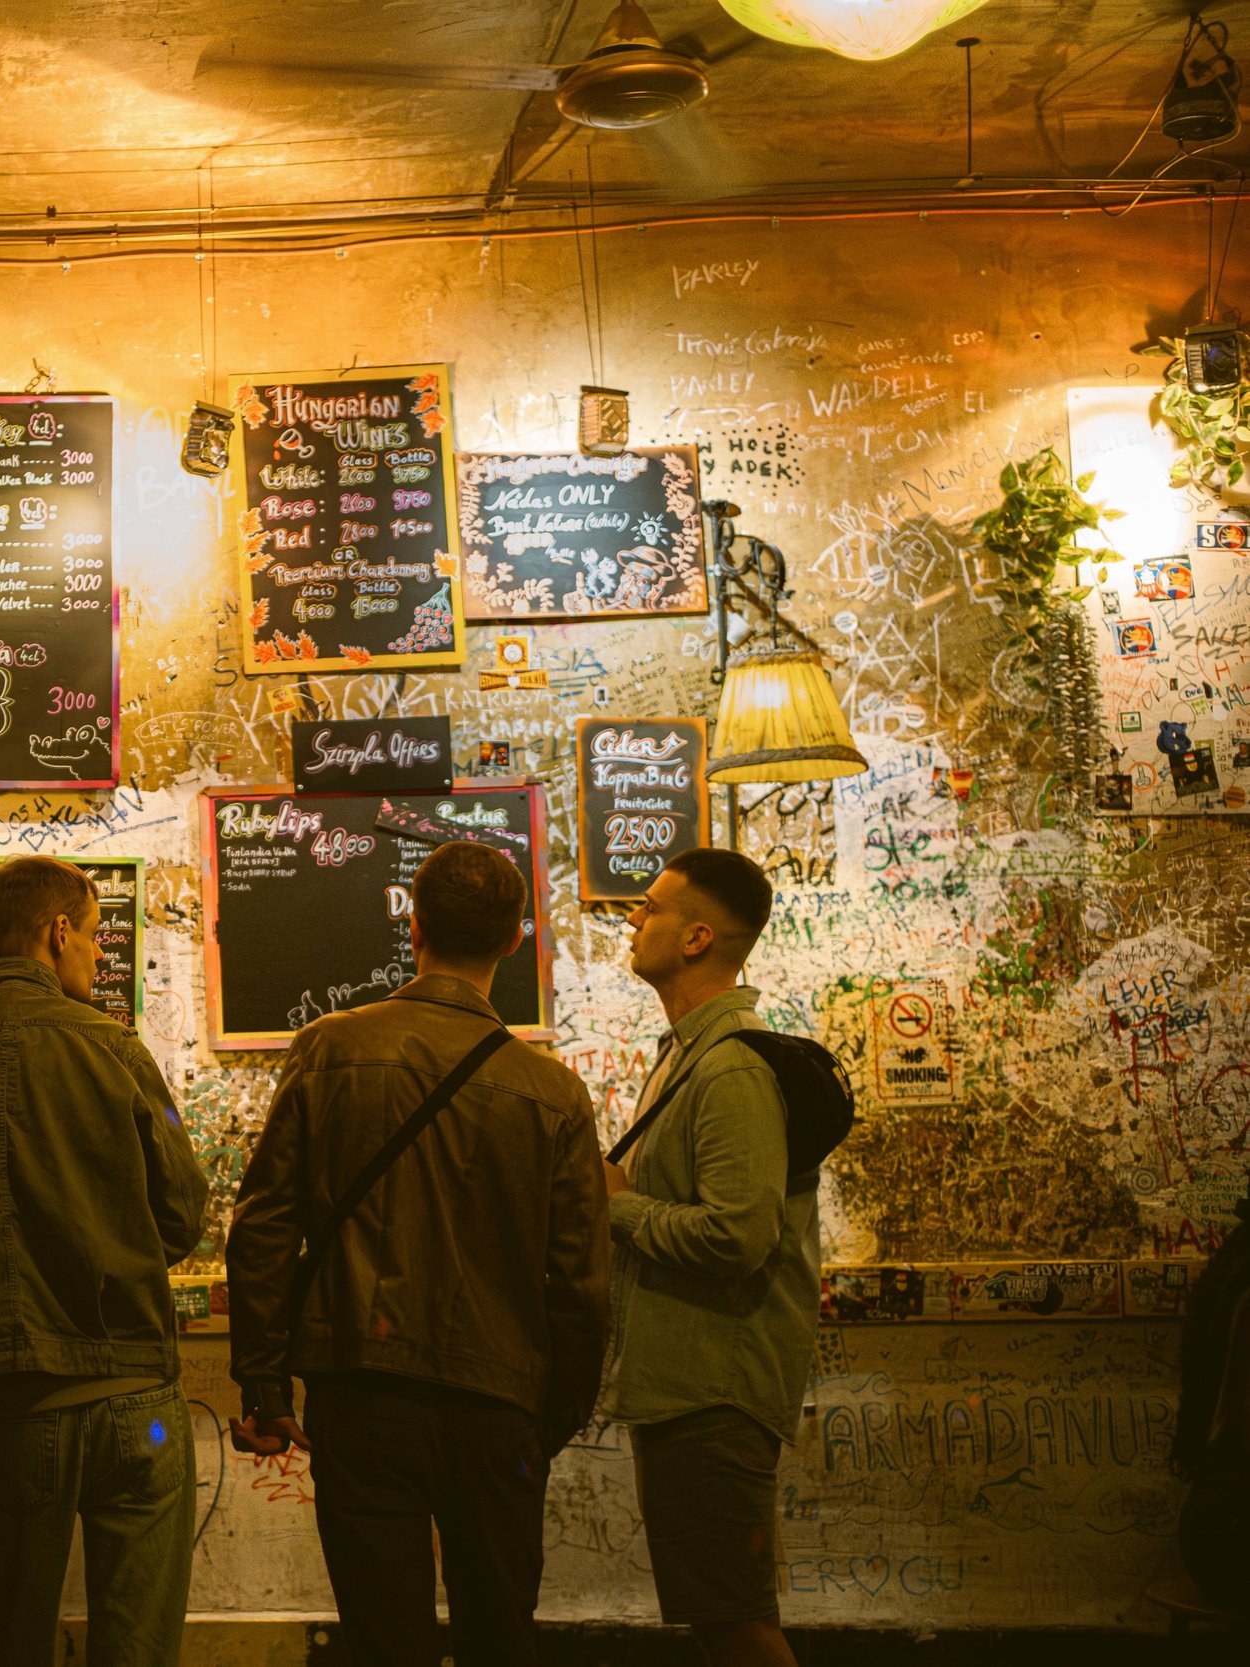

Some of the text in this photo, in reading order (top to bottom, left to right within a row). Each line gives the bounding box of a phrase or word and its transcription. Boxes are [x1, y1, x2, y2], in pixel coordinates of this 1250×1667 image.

[60, 449, 94, 467] 3000
[340, 451, 431, 466] Glass Bottle
[60, 470, 95, 485] 3000
[558, 484, 616, 506] ONLY
[62, 533, 103, 551] 3000
[62, 555, 104, 573] 3000
[64, 574, 103, 592] 3000
[357, 580, 397, 593] Bottle
[61, 597, 100, 612] 3000
[47, 686, 96, 714] 3000
[604, 814, 676, 853] 2500
[311, 827, 376, 867] 4800
[1101, 969, 1185, 1007] LEVER
[886, 1067, 945, 1084] SMOKING
